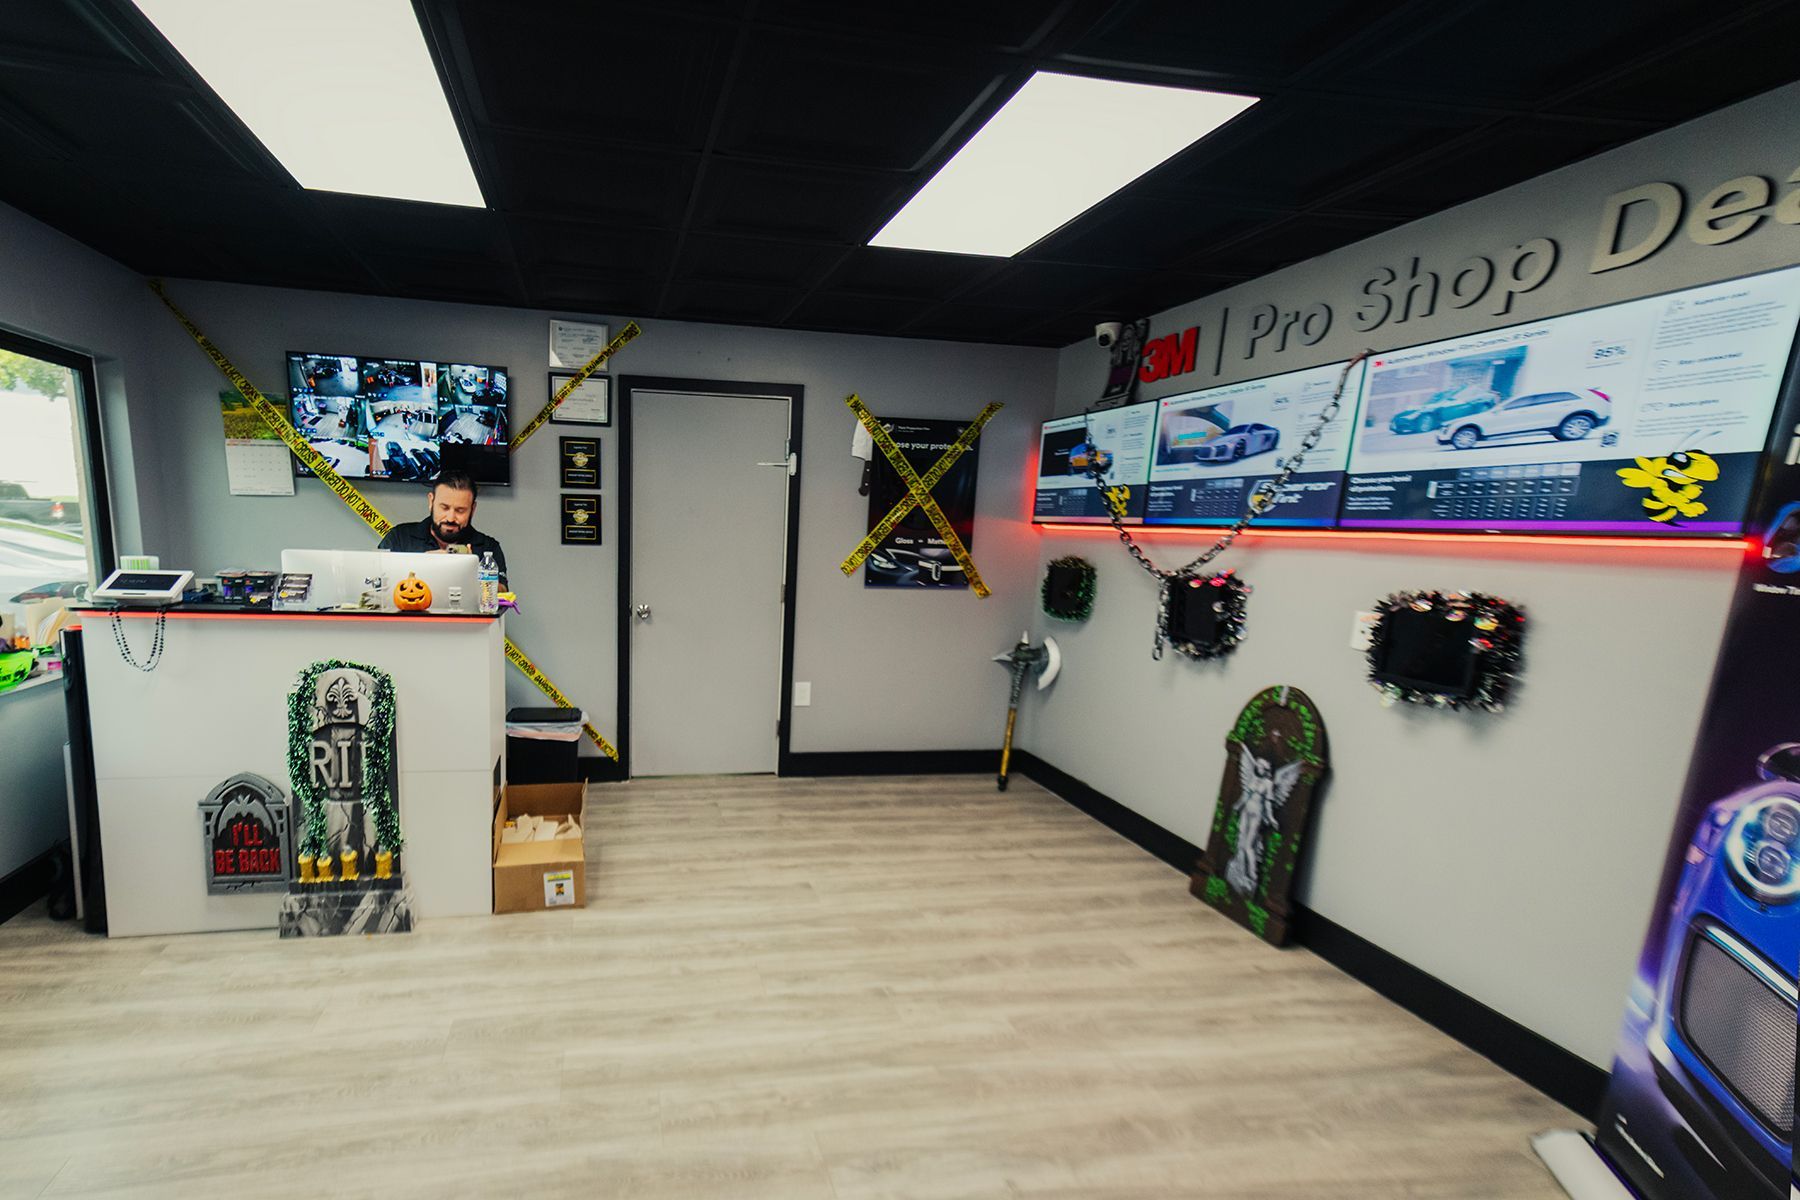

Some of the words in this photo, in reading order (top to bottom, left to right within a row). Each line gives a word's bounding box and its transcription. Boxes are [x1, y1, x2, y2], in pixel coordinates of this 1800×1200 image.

[1138, 326, 1199, 383] 3M
[1243, 303, 1333, 360] Pro
[1356, 237, 1560, 333] Shop
[911, 443, 929, 451] your
[294, 440, 317, 464] CROSS
[314, 460, 340, 487] DANGER
[335, 482, 349, 495] DO
[344, 490, 361, 507] NOT
[356, 501, 378, 524] CROSS
[374, 520, 390, 535] DAN
[895, 537, 914, 545] Gloss
[309, 740, 375, 790] RI
[232, 821, 263, 846] I'LL
[214, 849, 235, 874] BE
[239, 848, 281, 874] BACK
